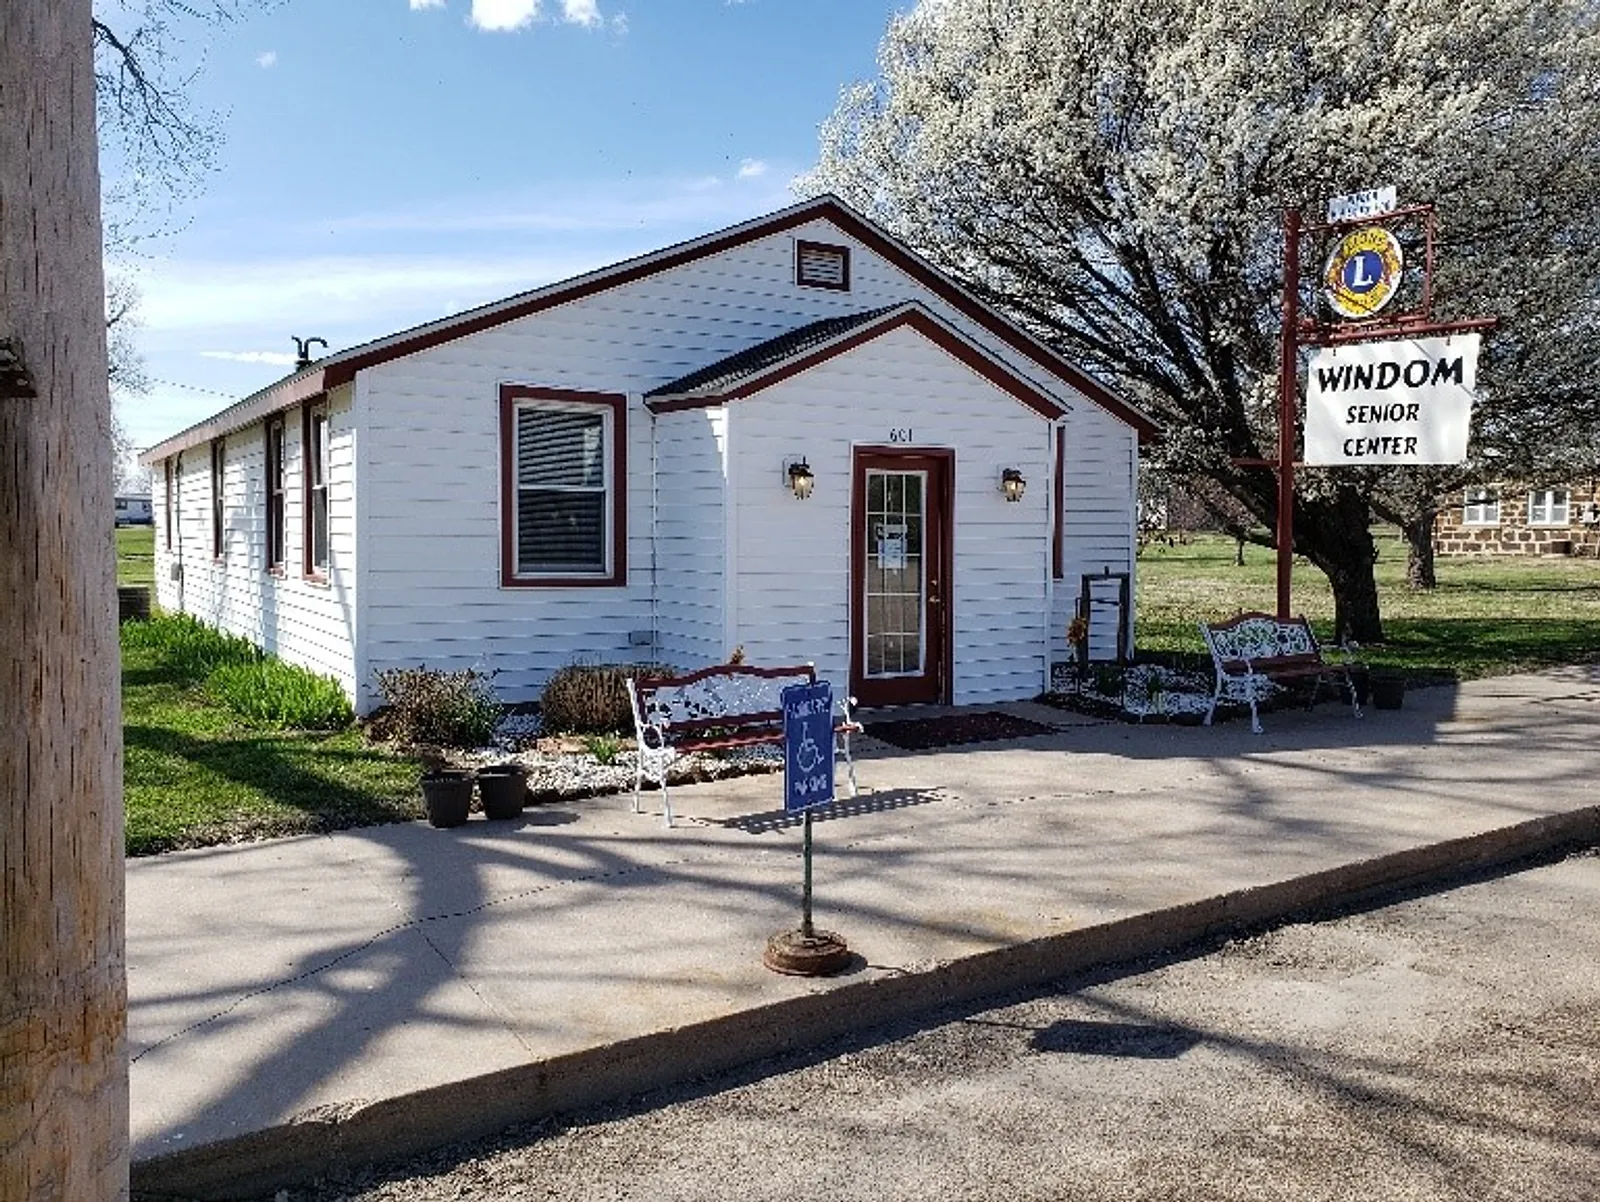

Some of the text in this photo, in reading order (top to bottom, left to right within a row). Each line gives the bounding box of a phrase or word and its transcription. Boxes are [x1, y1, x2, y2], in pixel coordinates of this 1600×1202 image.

[1352, 256, 1374, 287] L
[1317, 356, 1464, 393] WINDOM
[1346, 403, 1419, 424] SENIOR
[890, 428, 912, 442] 601
[1343, 437, 1418, 457] CENTER
